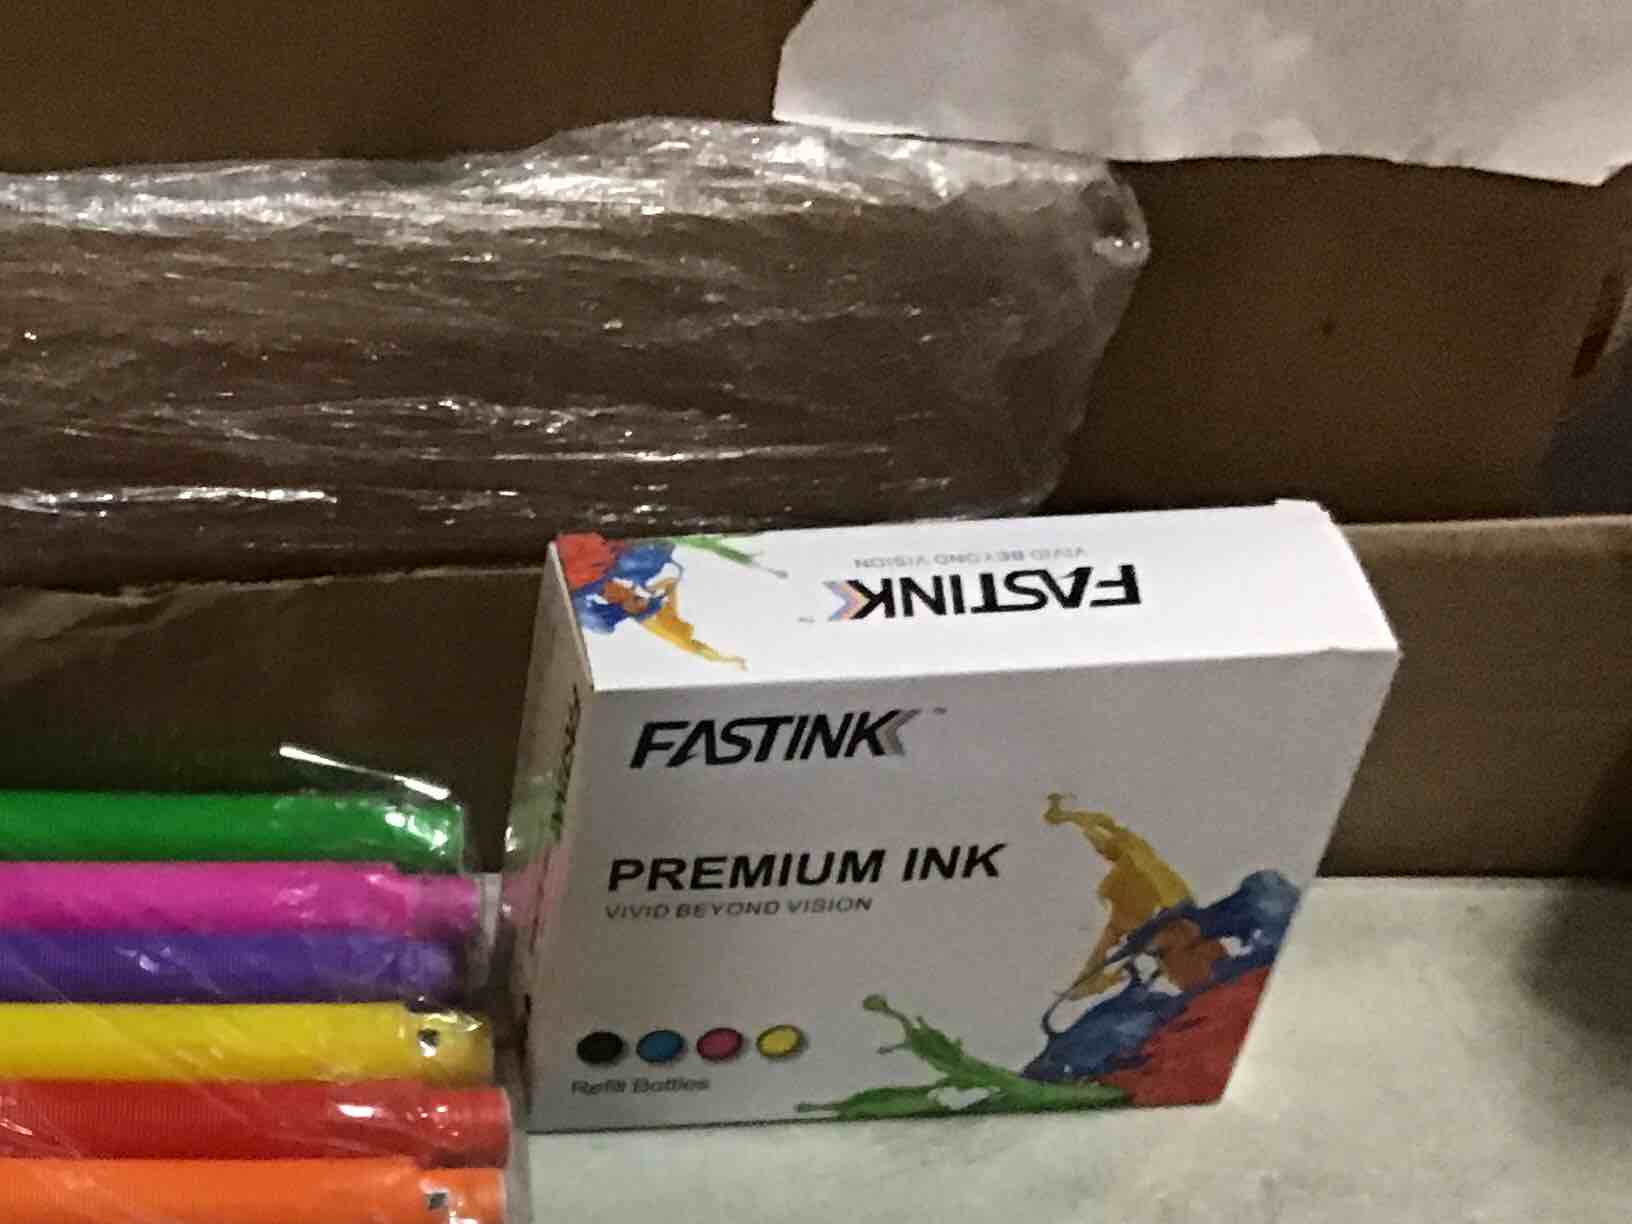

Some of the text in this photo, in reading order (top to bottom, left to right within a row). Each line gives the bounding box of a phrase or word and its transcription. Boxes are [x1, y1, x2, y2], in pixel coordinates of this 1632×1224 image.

[844, 563, 1142, 620] FASTINK
[628, 709, 903, 769] FASTINK
[607, 842, 1009, 893] PREMIUM INK
[605, 896, 874, 920] VIVID BEYOND VISION
